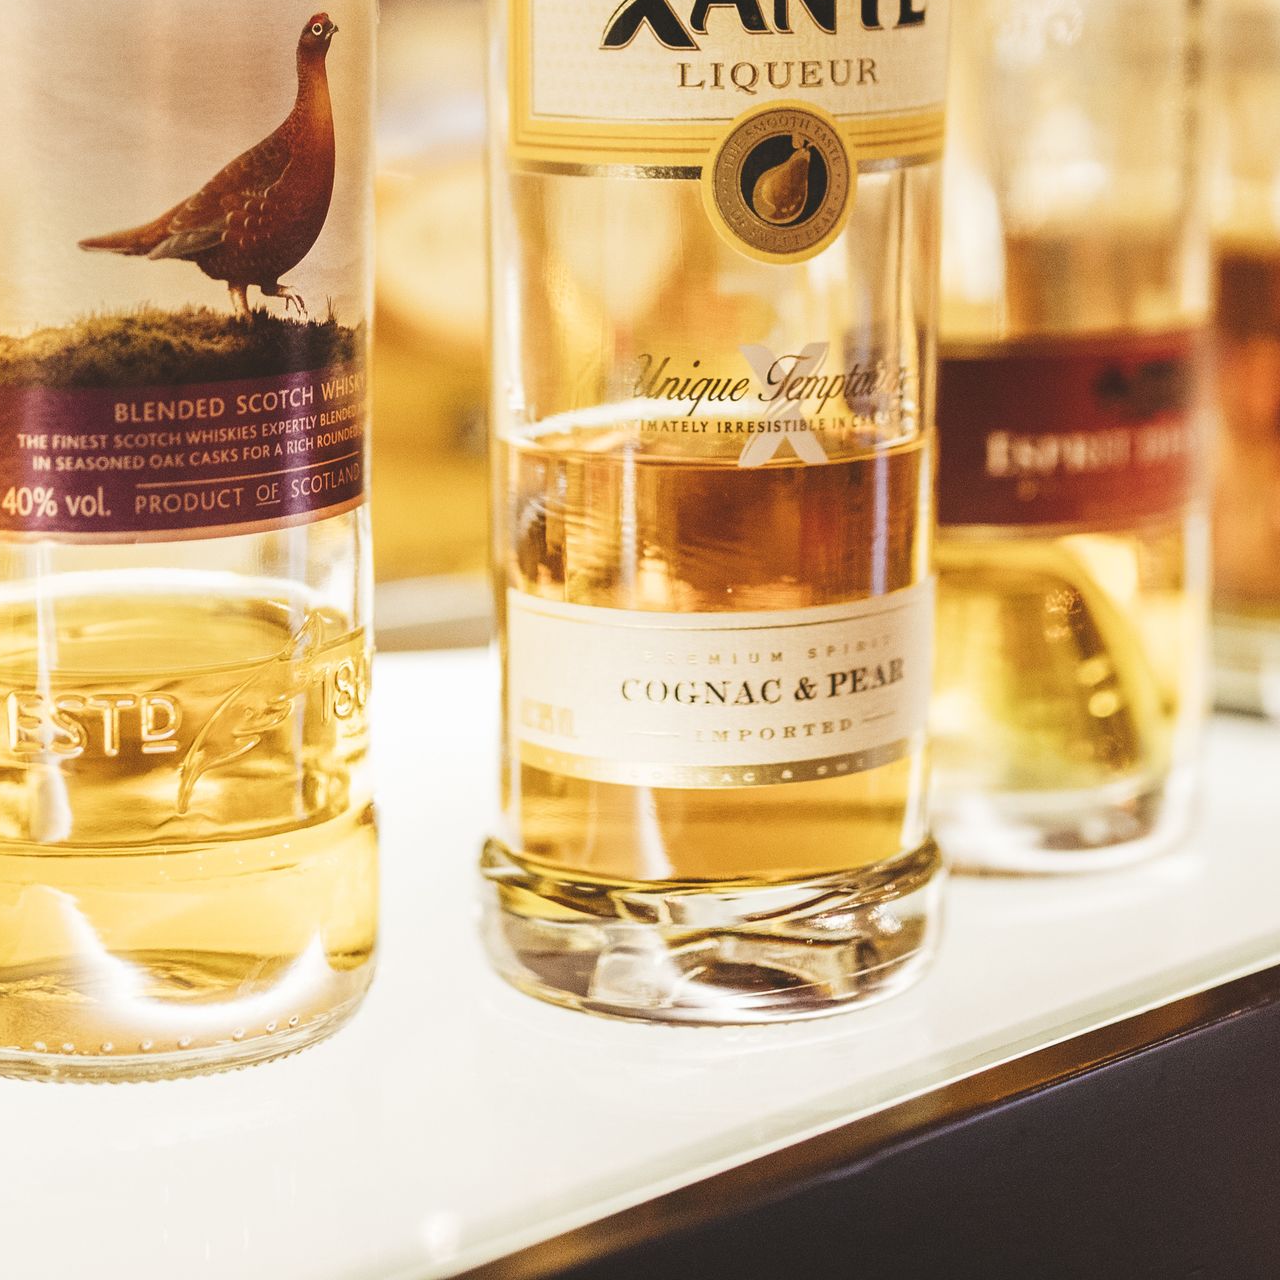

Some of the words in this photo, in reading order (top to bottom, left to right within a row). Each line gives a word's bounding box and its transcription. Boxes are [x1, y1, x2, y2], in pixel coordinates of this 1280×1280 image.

[676, 57, 879, 95] LIQUEUR
[745, 115, 811, 138] SMOOTH
[813, 125, 842, 165] TASTE
[805, 206, 837, 238] PEAR
[114, 396, 225, 423] BLENDED
[236, 385, 314, 415] SCOTCH
[632, 353, 750, 417] Unique
[17, 433, 49, 450] THE
[51, 433, 109, 451] FINEST
[113, 431, 181, 449] SCOTCH
[186, 424, 257, 444] WHISKIES
[261, 414, 318, 437] EXPERTLY
[320, 403, 356, 427] BLENDED
[716, 417, 825, 433] IRRESISTIBLE
[32, 455, 51, 470] IN
[55, 454, 145, 471] SEASONED
[149, 453, 184, 469] OAK
[189, 448, 239, 466] CASKS
[243, 445, 270, 460] FOR
[274, 442, 283, 456] A
[286, 437, 314, 455] RICH
[1, 486, 58, 517] 40%
[65, 486, 112, 517] vol.
[135, 487, 244, 515] PRODUCT
[256, 482, 281, 504] OF
[291, 463, 360, 498] SCOTLAND
[642, 650, 785, 666] PREMIUM
[806, 633, 894, 661] SPIRIT
[620, 677, 783, 705] COGNAC
[793, 675, 818, 702] &
[826, 656, 905, 699] PEAR
[7, 689, 183, 757] ESTD
[694, 716, 854, 744] IMPORTED
